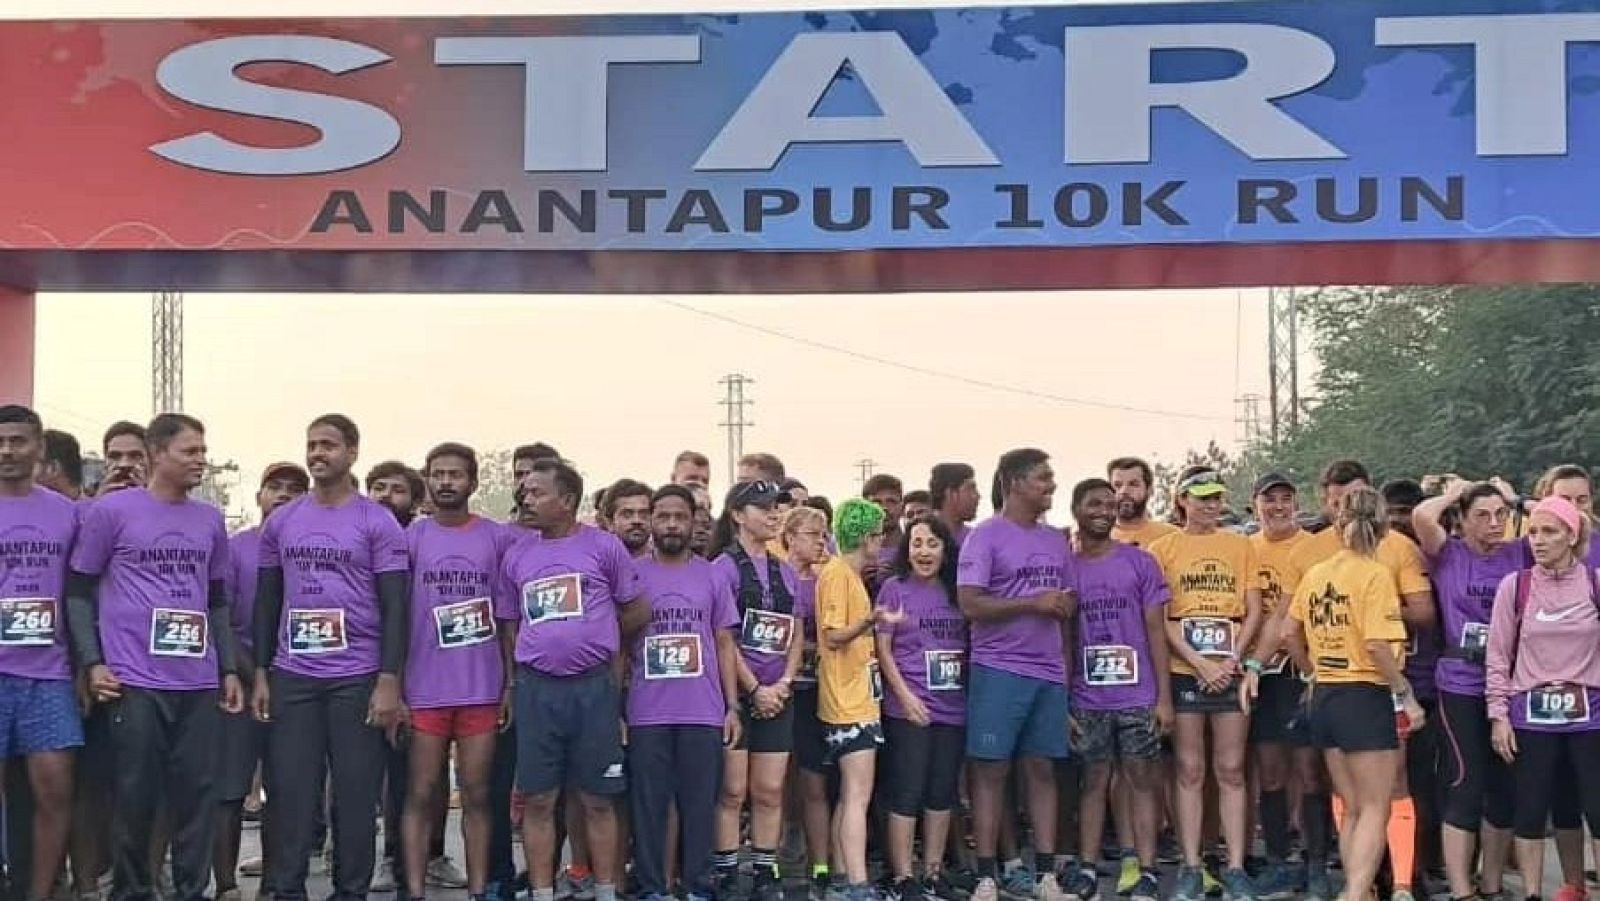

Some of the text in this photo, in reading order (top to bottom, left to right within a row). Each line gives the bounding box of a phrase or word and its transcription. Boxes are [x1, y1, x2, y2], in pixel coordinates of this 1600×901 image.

[149, 15, 1600, 177] START
[310, 175, 1464, 233] ANANTAPUR 10K RUN
[11, 611, 52, 629] 260
[164, 621, 200, 641] 256
[296, 621, 334, 639] 254
[1191, 628, 1225, 645] 020
[1540, 692, 1576, 710] 109
